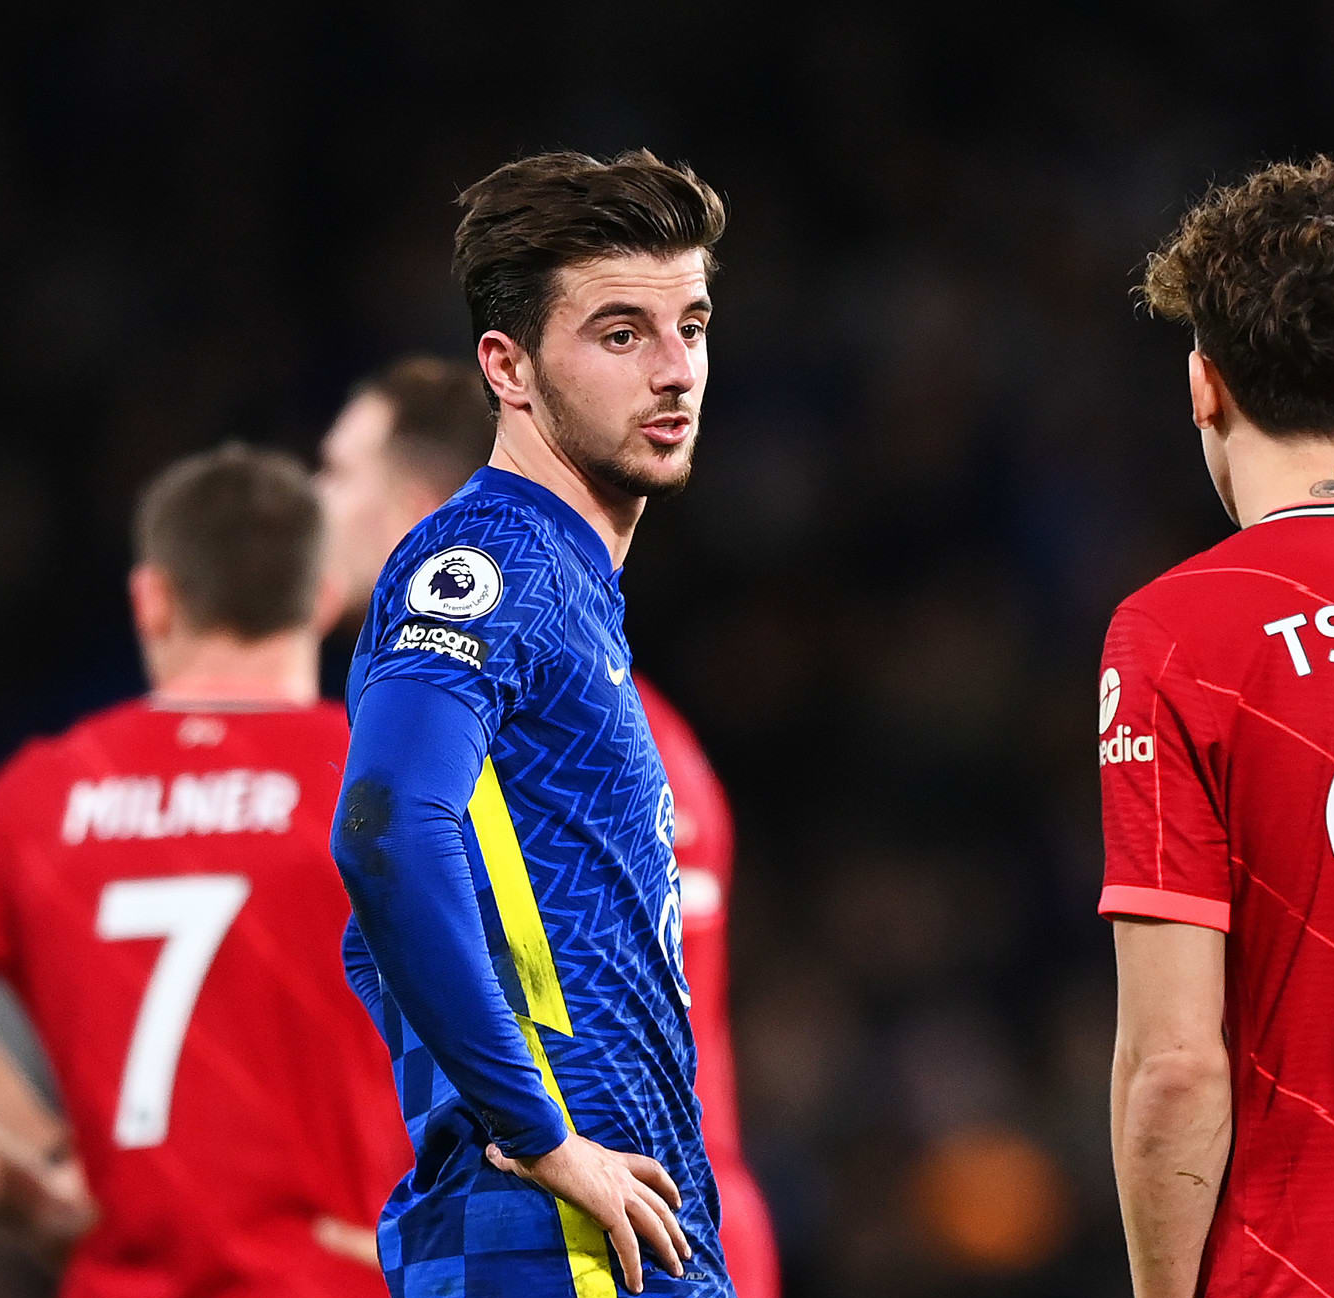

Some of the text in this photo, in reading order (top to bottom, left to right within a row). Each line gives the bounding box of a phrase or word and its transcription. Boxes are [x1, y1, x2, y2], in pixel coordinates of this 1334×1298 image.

[443, 584, 489, 612] Premier League
[399, 625, 479, 657] No room
[62, 768, 301, 846] MILNER
[93, 872, 252, 1150] 7
